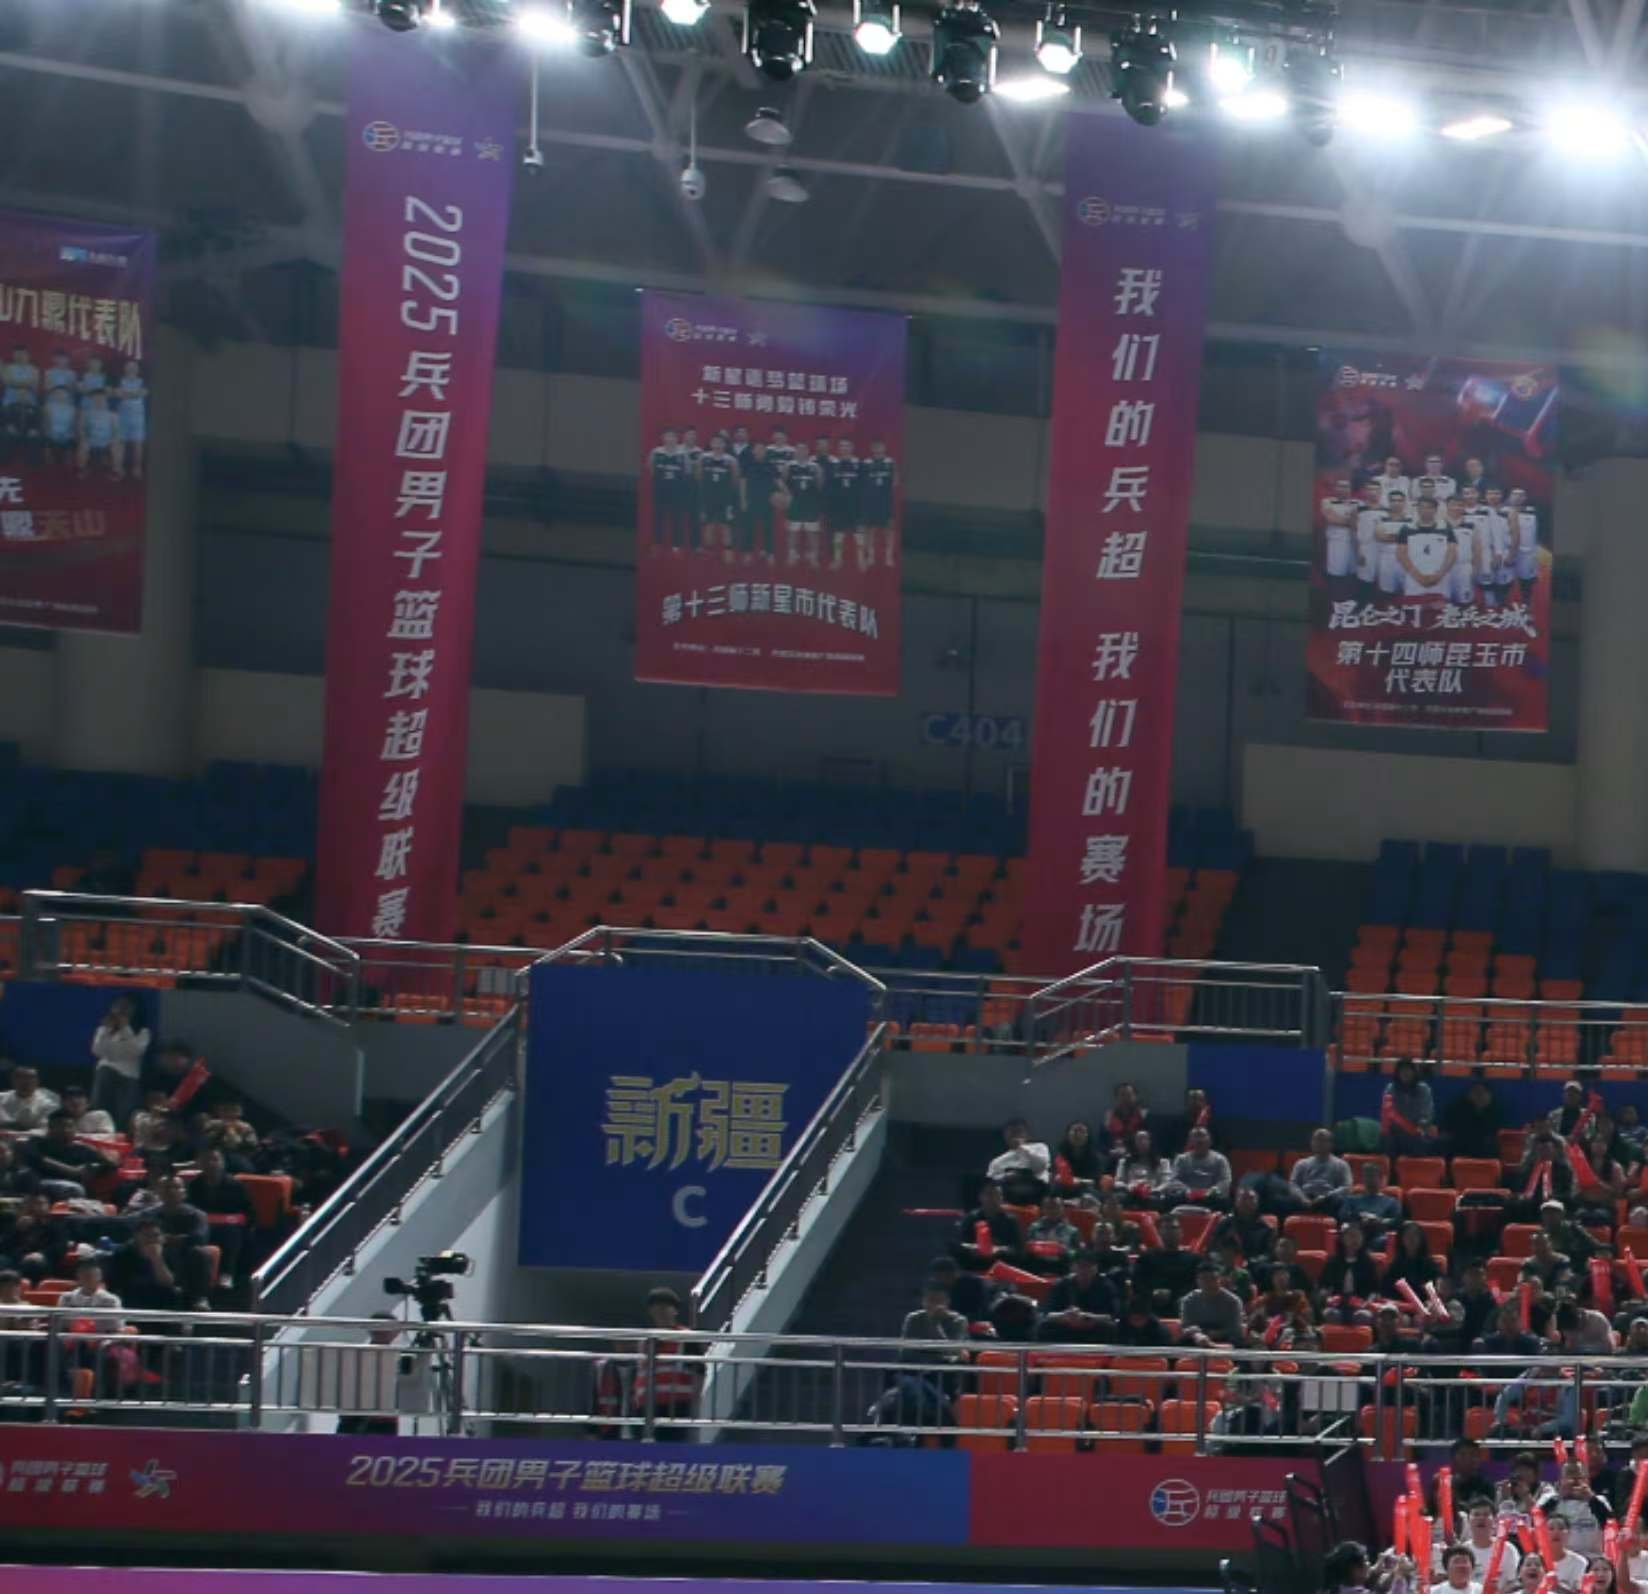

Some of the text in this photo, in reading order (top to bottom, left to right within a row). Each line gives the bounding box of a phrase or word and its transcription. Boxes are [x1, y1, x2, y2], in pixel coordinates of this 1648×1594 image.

[1096, 268, 1163, 580] 我们的兵超
[1335, 640, 1530, 669] 第十四师昆玉市
[1384, 667, 1465, 694] 代表队
[923, 712, 1027, 753] C404
[1073, 631, 1140, 953] 我们的赛场
[600, 1071, 792, 1171] 新疆
[671, 1184, 710, 1229] C
[345, 1455, 788, 1497] 2025兵团男子篮球超级联赛
